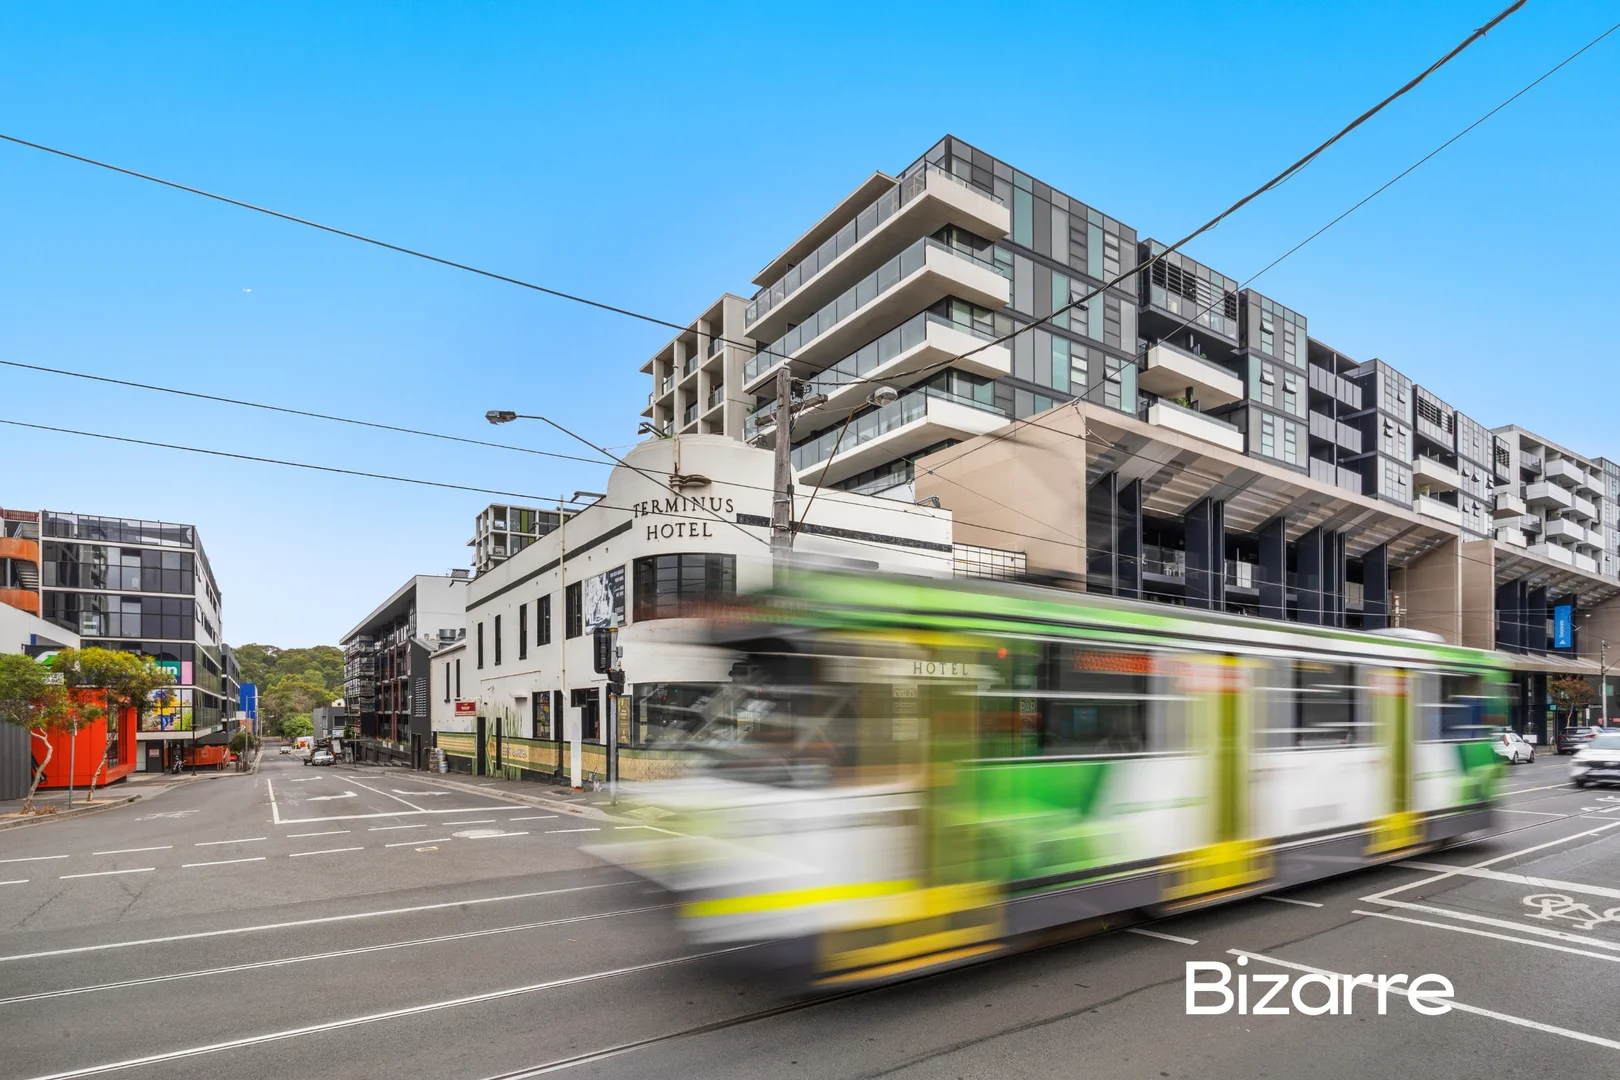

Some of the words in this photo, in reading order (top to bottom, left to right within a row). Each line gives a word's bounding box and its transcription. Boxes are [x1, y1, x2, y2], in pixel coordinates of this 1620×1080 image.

[633, 496, 734, 518] TERMINUS
[647, 522, 713, 541] HOTEL
[913, 661, 969, 676] HOTEL
[1020, 701, 1036, 713] BAR
